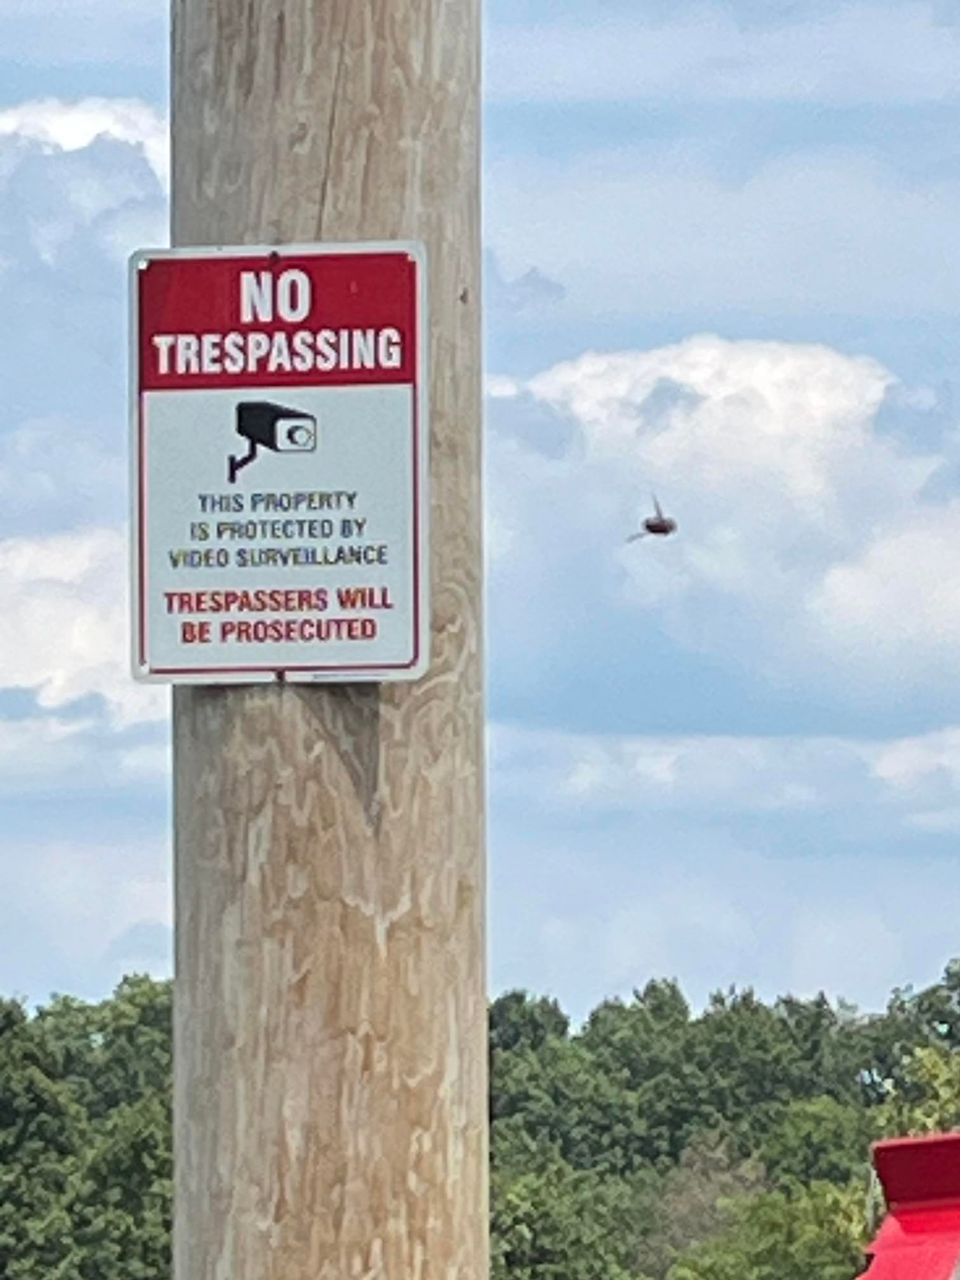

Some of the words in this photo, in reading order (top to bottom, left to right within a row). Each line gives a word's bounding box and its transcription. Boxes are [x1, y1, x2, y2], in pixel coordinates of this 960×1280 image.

[240, 269, 311, 325] NO
[153, 328, 401, 375] TRESPASSING
[199, 494, 243, 513] THIS
[250, 491, 357, 511] PROPERTY
[191, 522, 209, 541] IS
[217, 519, 333, 540] PROTECTED
[340, 518, 366, 538] BY
[169, 549, 228, 569] VIDEO
[237, 545, 388, 567] SURVEILLANCE
[164, 588, 328, 614] TRESPASSERS
[337, 586, 393, 611] WILL
[181, 622, 211, 644] BE
[220, 618, 376, 643] PROSECUTED
